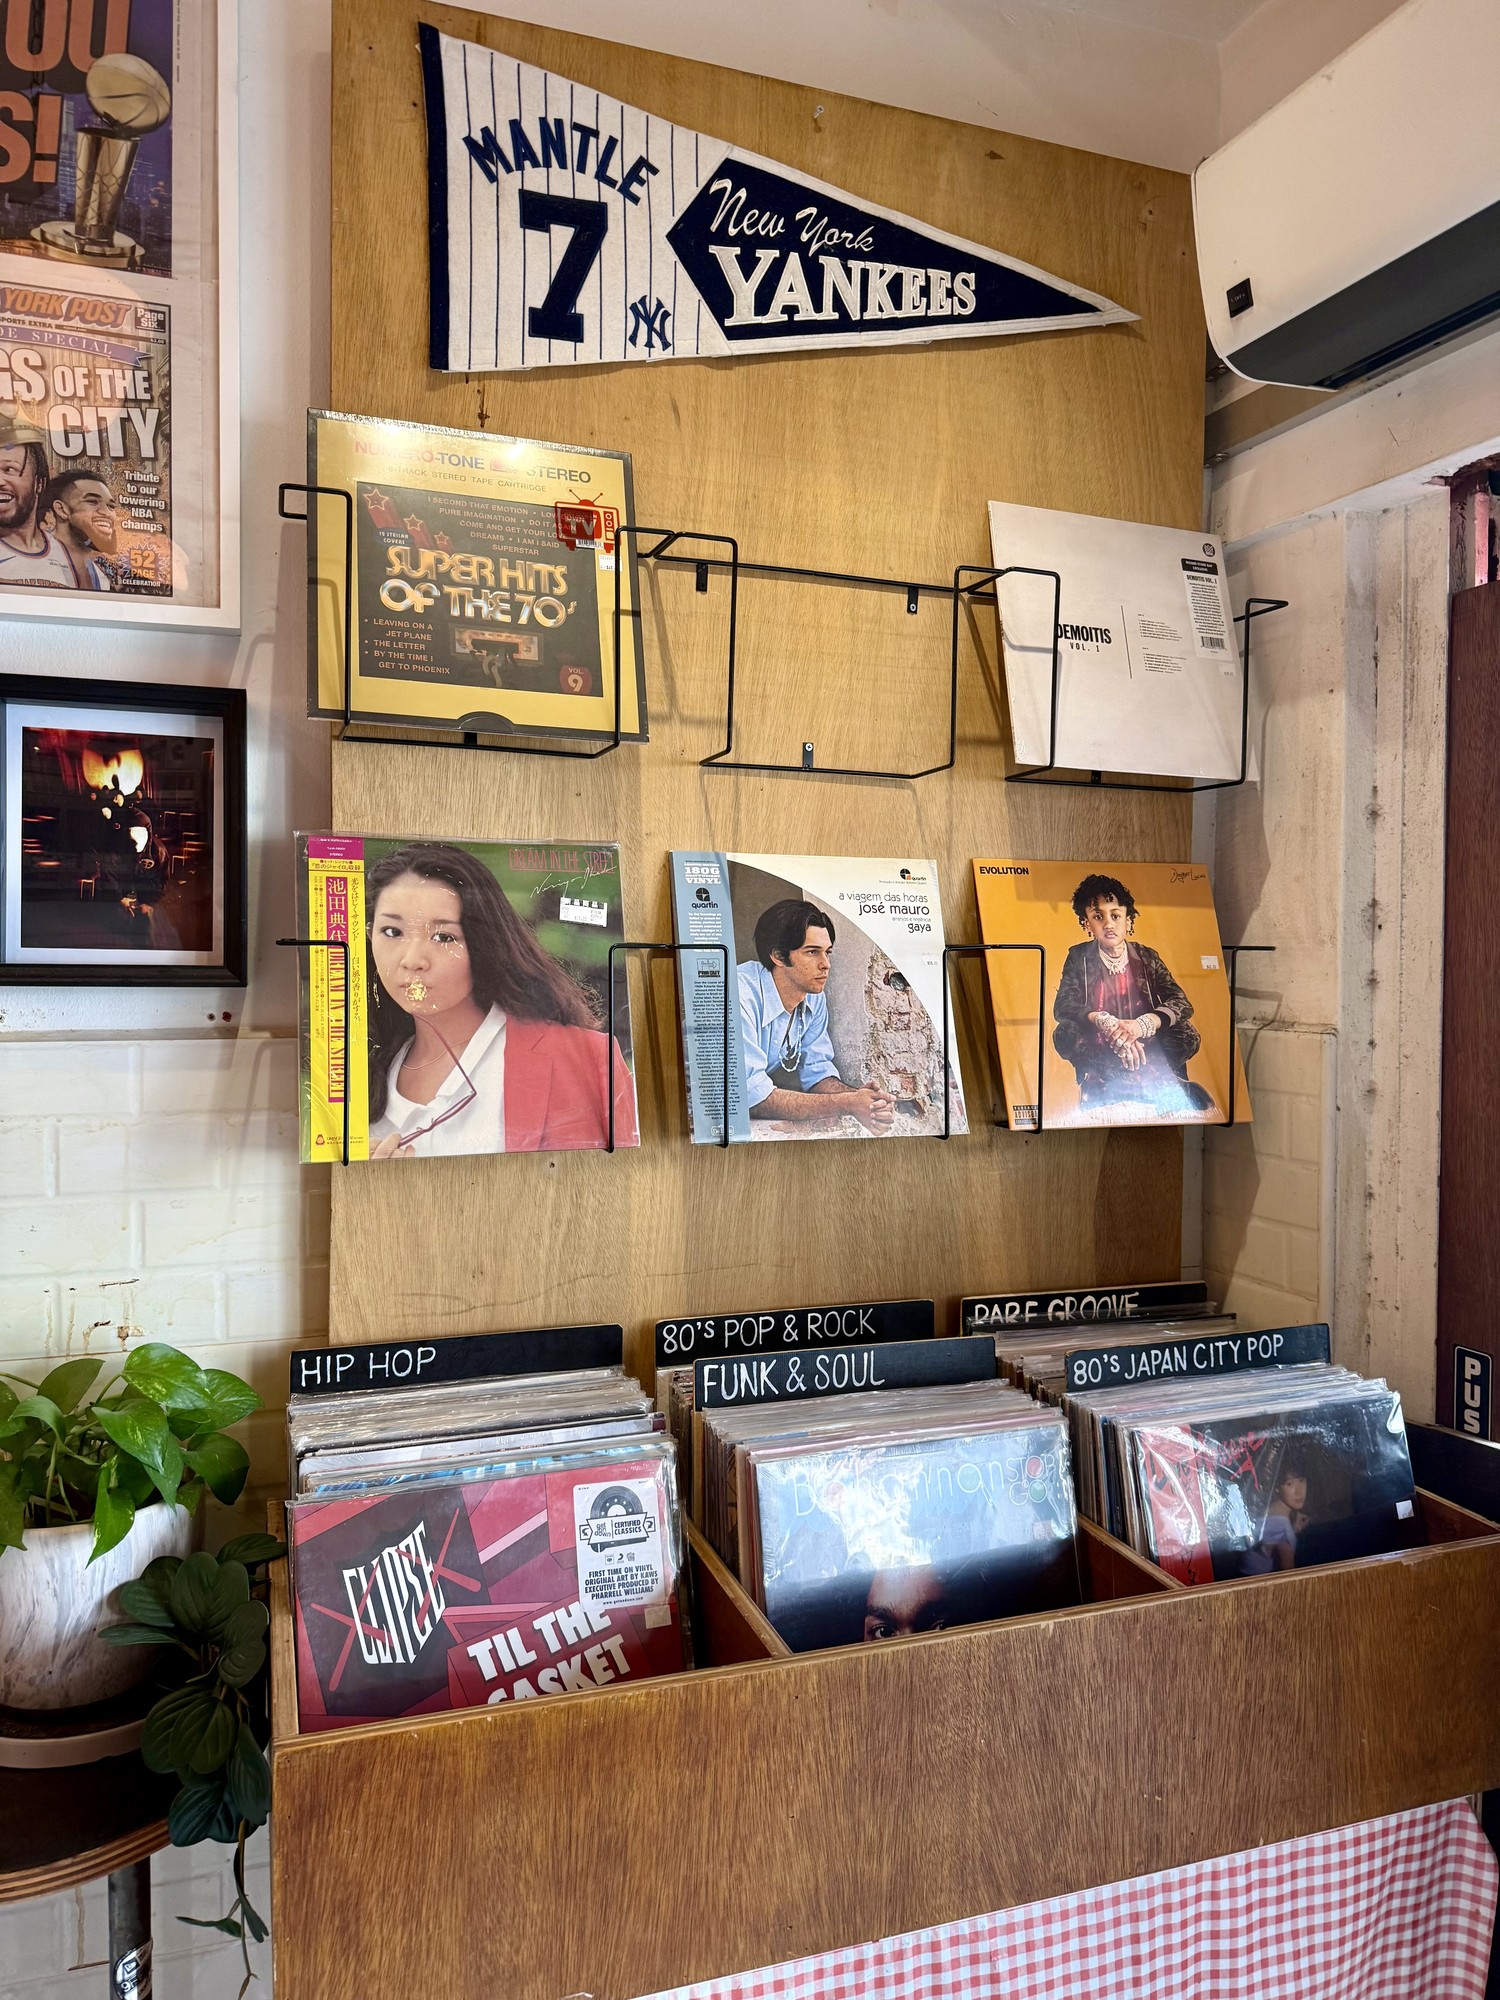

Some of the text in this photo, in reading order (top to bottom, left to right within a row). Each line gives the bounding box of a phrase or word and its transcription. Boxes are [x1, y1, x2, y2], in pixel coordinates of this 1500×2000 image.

[462, 117, 660, 206] MANTLE
[708, 178, 876, 258] New York
[517, 189, 609, 343] 7
[708, 245, 976, 327] YANKEES
[3, 287, 132, 327] YORK POST
[137, 308, 165, 322] Page
[28, 320, 53, 329] EXTRA
[31, 331, 113, 355] SPECIAL
[53, 365, 89, 398] OF
[95, 366, 151, 400] THE
[49, 403, 161, 459] CITY
[124, 470, 160, 483] Tribute
[432, 471, 467, 482] STEREO
[472, 477, 493, 486] TAPE
[497, 480, 547, 493] CARTRIDGE
[526, 465, 592, 484] STEREO
[126, 483, 157, 495] to our
[119, 494, 165, 510] towering
[432, 497, 467, 507] SECOND
[469, 501, 490, 510] THAT
[491, 502, 529, 515] EMOTION
[131, 507, 153, 519] NBA
[439, 508, 462, 517] PURE
[463, 511, 517, 524] IMAGINATION
[529, 519, 539, 527] DO
[542, 520, 550, 528] IT
[121, 519, 163, 533] champs
[459, 520, 484, 529] COME
[486, 523, 504, 531] AND
[505, 526, 522, 534] GET
[523, 527, 546, 537] YOUR
[470, 531, 505, 542] DREAMS
[521, 538, 536, 546] AM
[540, 540, 560, 549] SAID
[492, 544, 540, 556] SUPERSTAR
[130, 549, 155, 569] 52
[130, 568, 155, 579] PAGE
[385, 544, 569, 597] SUPER HITS
[122, 578, 161, 587] CELEBRATION
[379, 578, 441, 614] OF
[442, 584, 512, 623] THE
[373, 618, 410, 629] LEAVING
[427, 623, 434, 631] A
[404, 632, 432, 641] PLANE
[1056, 622, 1113, 645] DEMOITIS
[373, 639, 426, 651] THE LETTER
[1069, 642, 1100, 653] VOL. 1
[374, 650, 386, 658] BY
[388, 651, 405, 660] THE
[407, 653, 429, 662] TIME
[378, 661, 450, 675] GET TO PHOENIX
[568, 667, 585, 675] VOL.
[567, 674, 583, 692] 9
[507, 848, 615, 873] DREAM IN THE STREET
[684, 866, 720, 875] 180G
[979, 866, 1029, 876] EVOLUTION
[685, 877, 721, 885] VINYL
[691, 901, 719, 909] quartin
[846, 891, 882, 903] viagem
[884, 892, 901, 902] das
[903, 892, 928, 903] horas
[859, 901, 930, 915] josé mauro
[908, 922, 931, 933] gaya
[329, 950, 346, 993] DREAM
[1014, 1110, 1038, 1118] ADVISOR
[1047, 1291, 1140, 1323] GROOVE
[724, 1315, 775, 1349] POP
[782, 1313, 799, 1343] &
[806, 1307, 877, 1341] ROCK
[1124, 1345, 1188, 1381] JAPAN
[1193, 1339, 1241, 1370] CITY
[1246, 1333, 1284, 1362] POP
[299, 1346, 437, 1388] HIP HOP
[703, 1350, 886, 1403] FUNK & SOUL
[1463, 1355, 1482, 1435] PUS
[1006, 1454, 1056, 1482] STOP
[1008, 1479, 1047, 1506] GO
[595, 1522, 606, 1531] get
[614, 1519, 641, 1529] CERTIFIED
[614, 1525, 642, 1535] CLASSICS
[594, 1530, 612, 1538] down
[584, 1570, 658, 1586] ORIGINAL ART BY KAWS
[588, 1563, 654, 1579] FIRST TIME ON VINYL
[584, 1577, 659, 1594] EXECUTIVE PRODUCED BY
[591, 1586, 654, 1600] PHARRELL WILLIAMS
[465, 1600, 613, 1683] TIL THE
